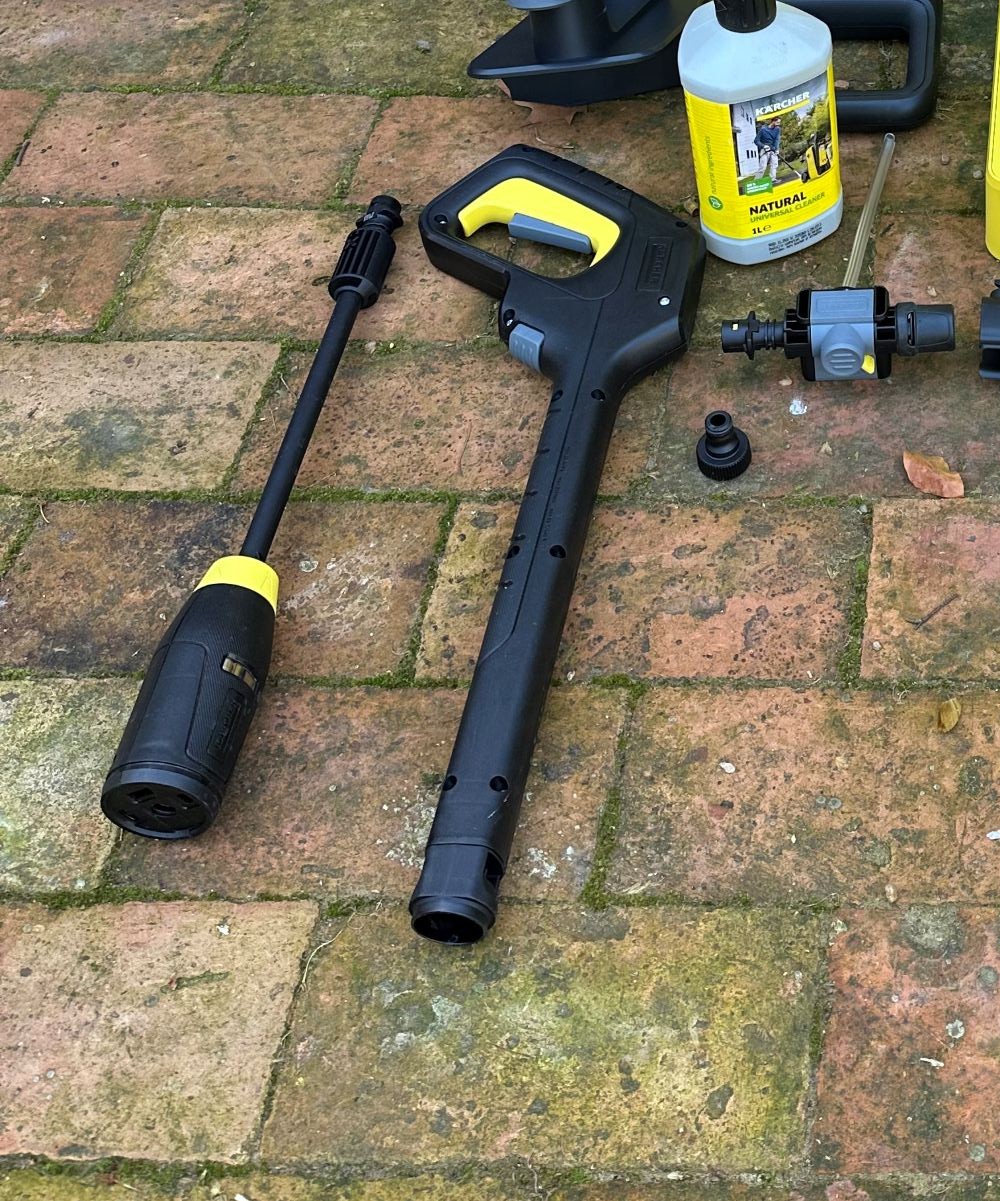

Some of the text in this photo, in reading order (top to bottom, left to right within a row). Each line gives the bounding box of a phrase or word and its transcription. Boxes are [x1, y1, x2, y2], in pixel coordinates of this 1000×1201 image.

[755, 91, 810, 116] KÄRCHER
[750, 192, 807, 215] NATURAL
[750, 192, 825, 223] UNIVERSAL CLEANER
